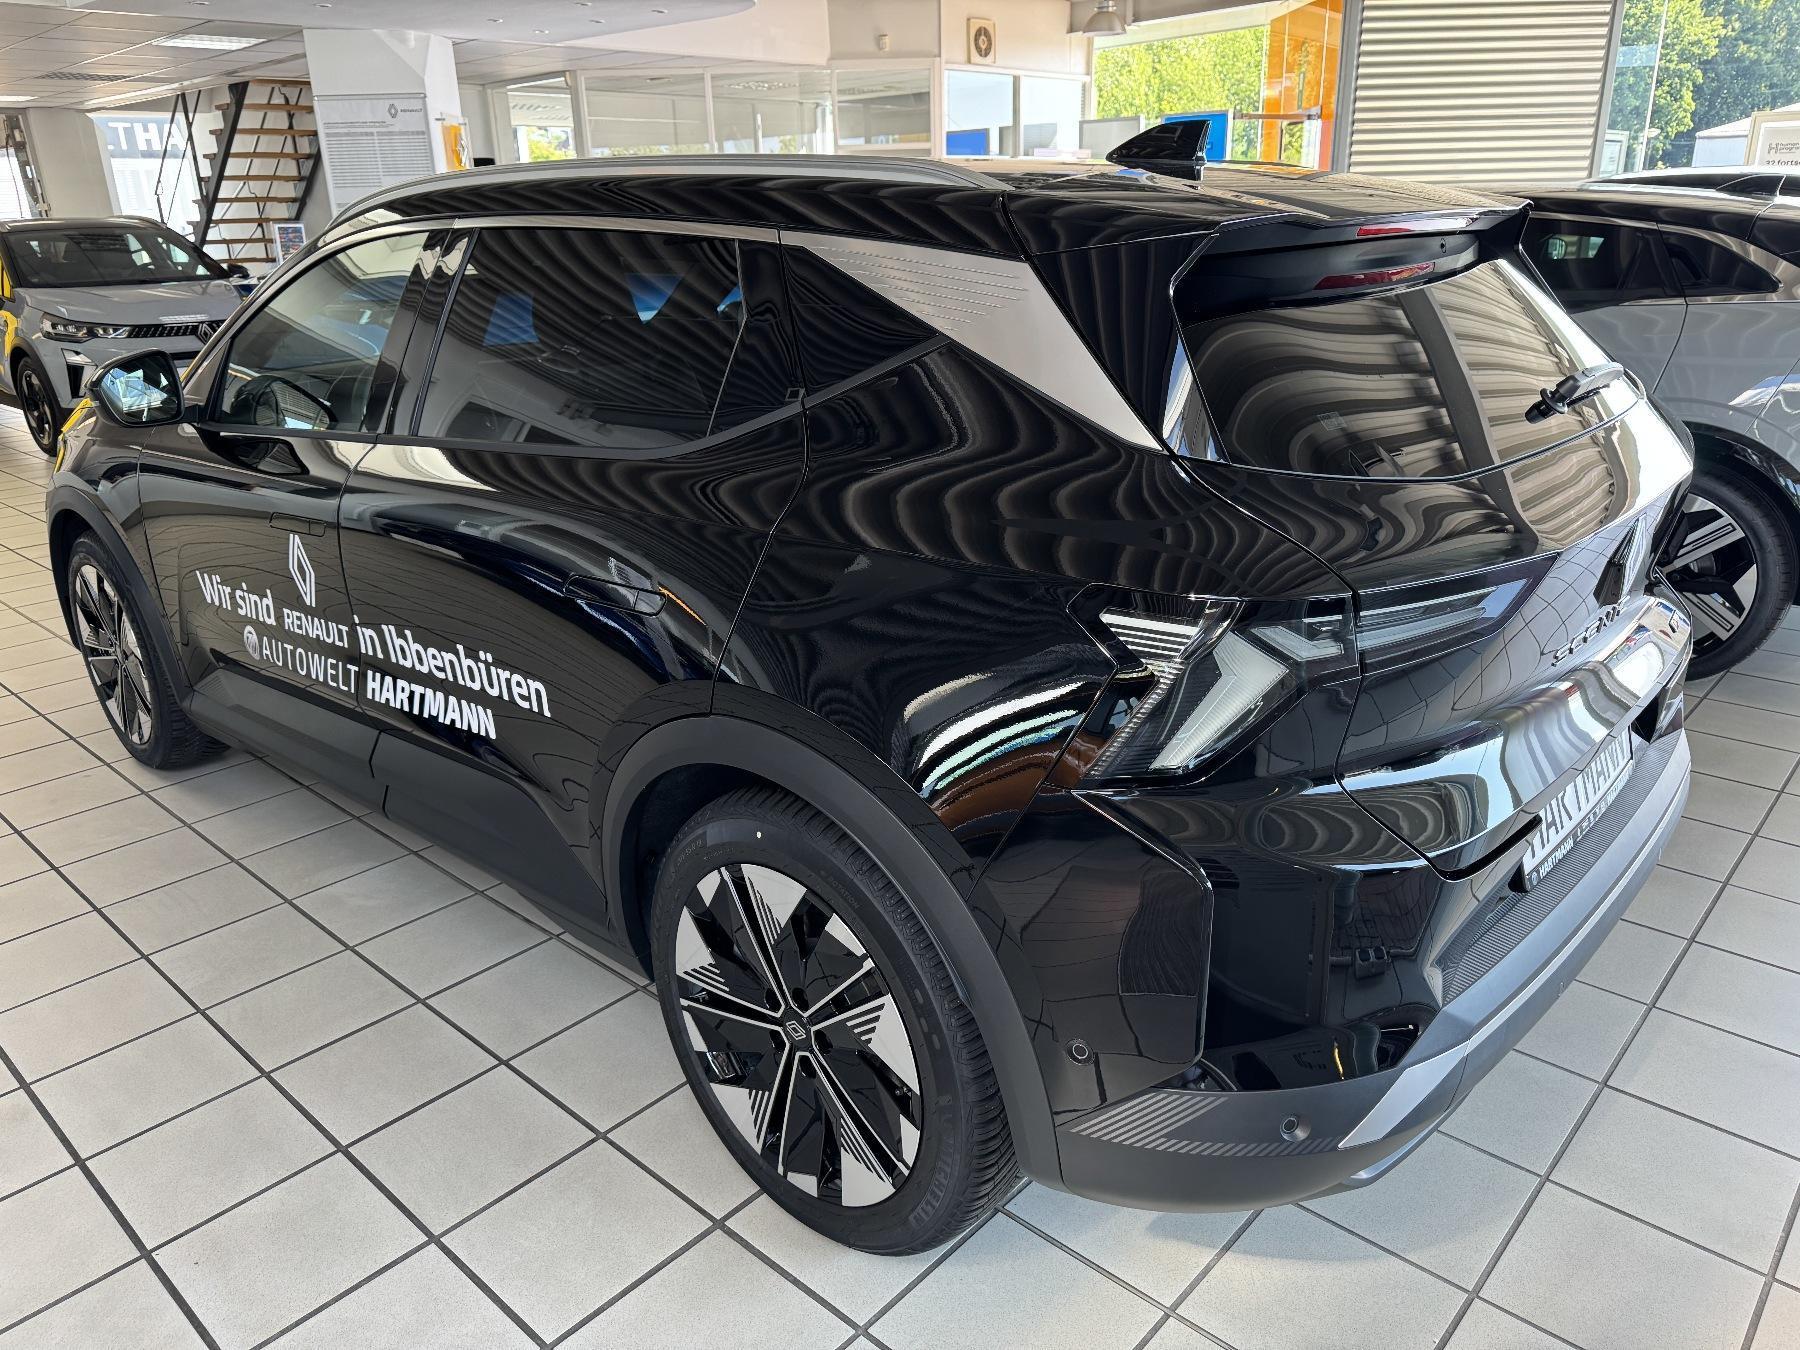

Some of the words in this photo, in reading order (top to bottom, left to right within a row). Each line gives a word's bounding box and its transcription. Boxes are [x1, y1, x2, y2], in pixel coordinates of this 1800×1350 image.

[196, 570, 232, 610] Wir
[235, 582, 276, 626] sind
[282, 607, 349, 648] RENAULT
[353, 614, 384, 659] in
[381, 624, 551, 717] Ibbenbüren
[262, 636, 359, 694] AUTOWELT
[366, 669, 496, 740] HARTMANN
